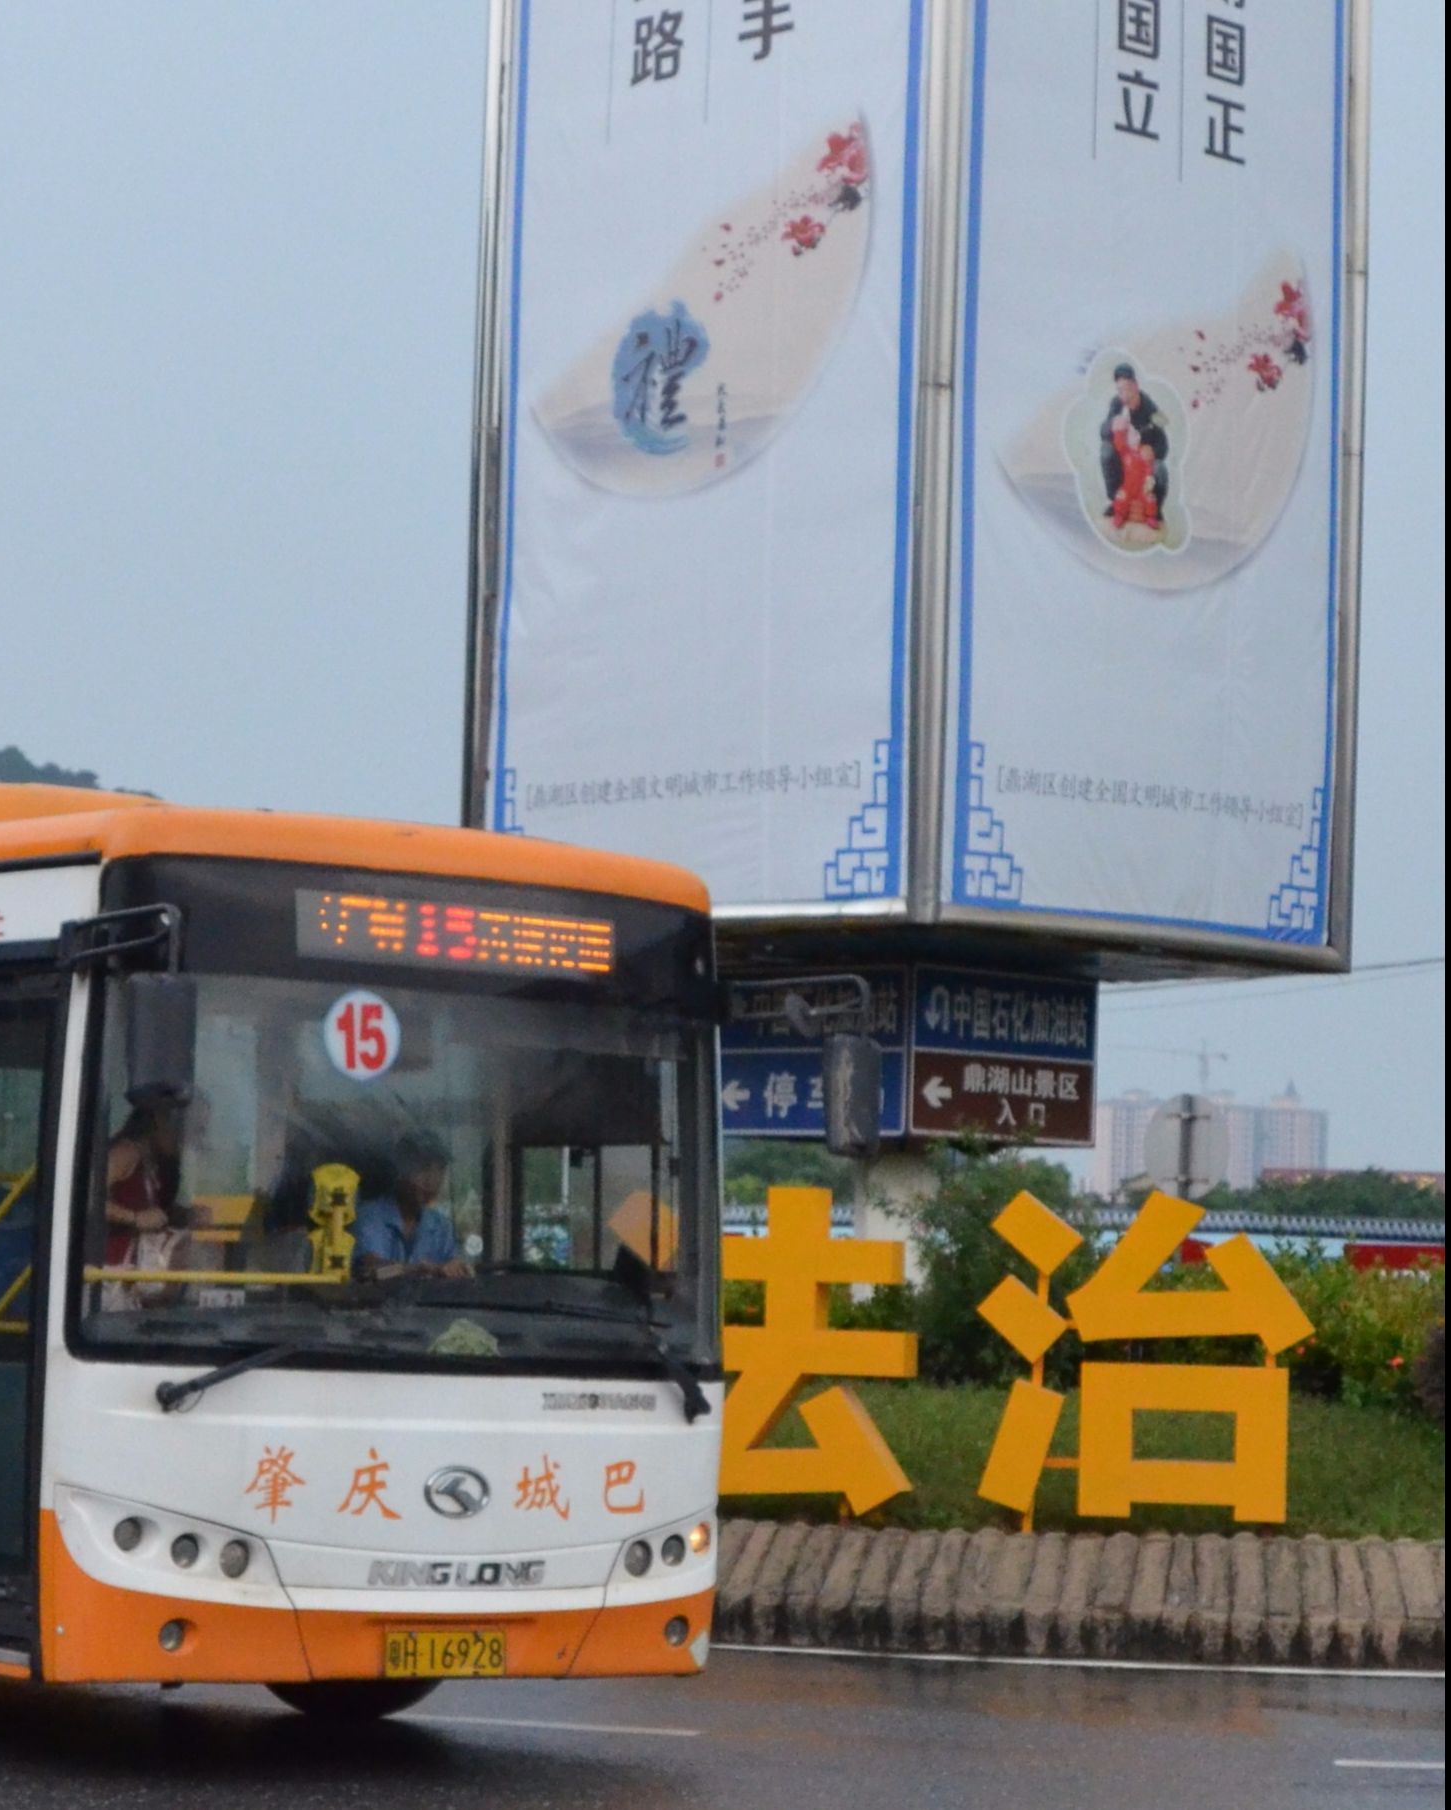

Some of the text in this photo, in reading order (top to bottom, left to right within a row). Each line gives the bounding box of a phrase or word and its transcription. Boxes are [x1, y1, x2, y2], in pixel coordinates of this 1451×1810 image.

[1204, 0, 1246, 166] 国正
[336, 1002, 387, 1071] 15
[953, 989, 1088, 1049] 中国石化加油站
[963, 1062, 1081, 1103] 鼎湖山景区
[996, 1099, 1047, 1128] 入口
[245, 1445, 645, 1524] 肇庆 城巴
[367, 1560, 546, 1588] KING LONG
